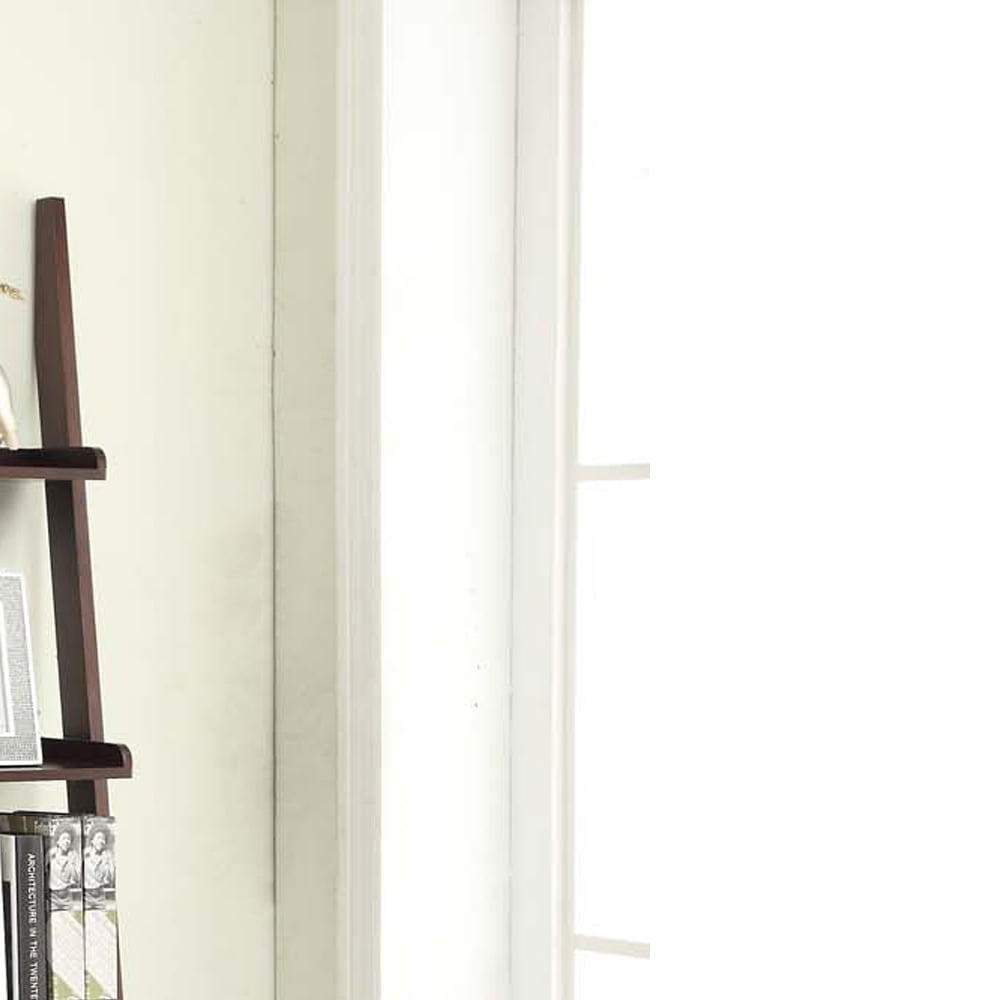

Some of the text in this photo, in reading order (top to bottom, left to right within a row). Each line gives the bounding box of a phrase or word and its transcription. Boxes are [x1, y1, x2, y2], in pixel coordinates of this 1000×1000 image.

[27, 853, 37, 924] ARCHITECTURE
[29, 927, 37, 937] IN
[29, 941, 38, 959] THE
